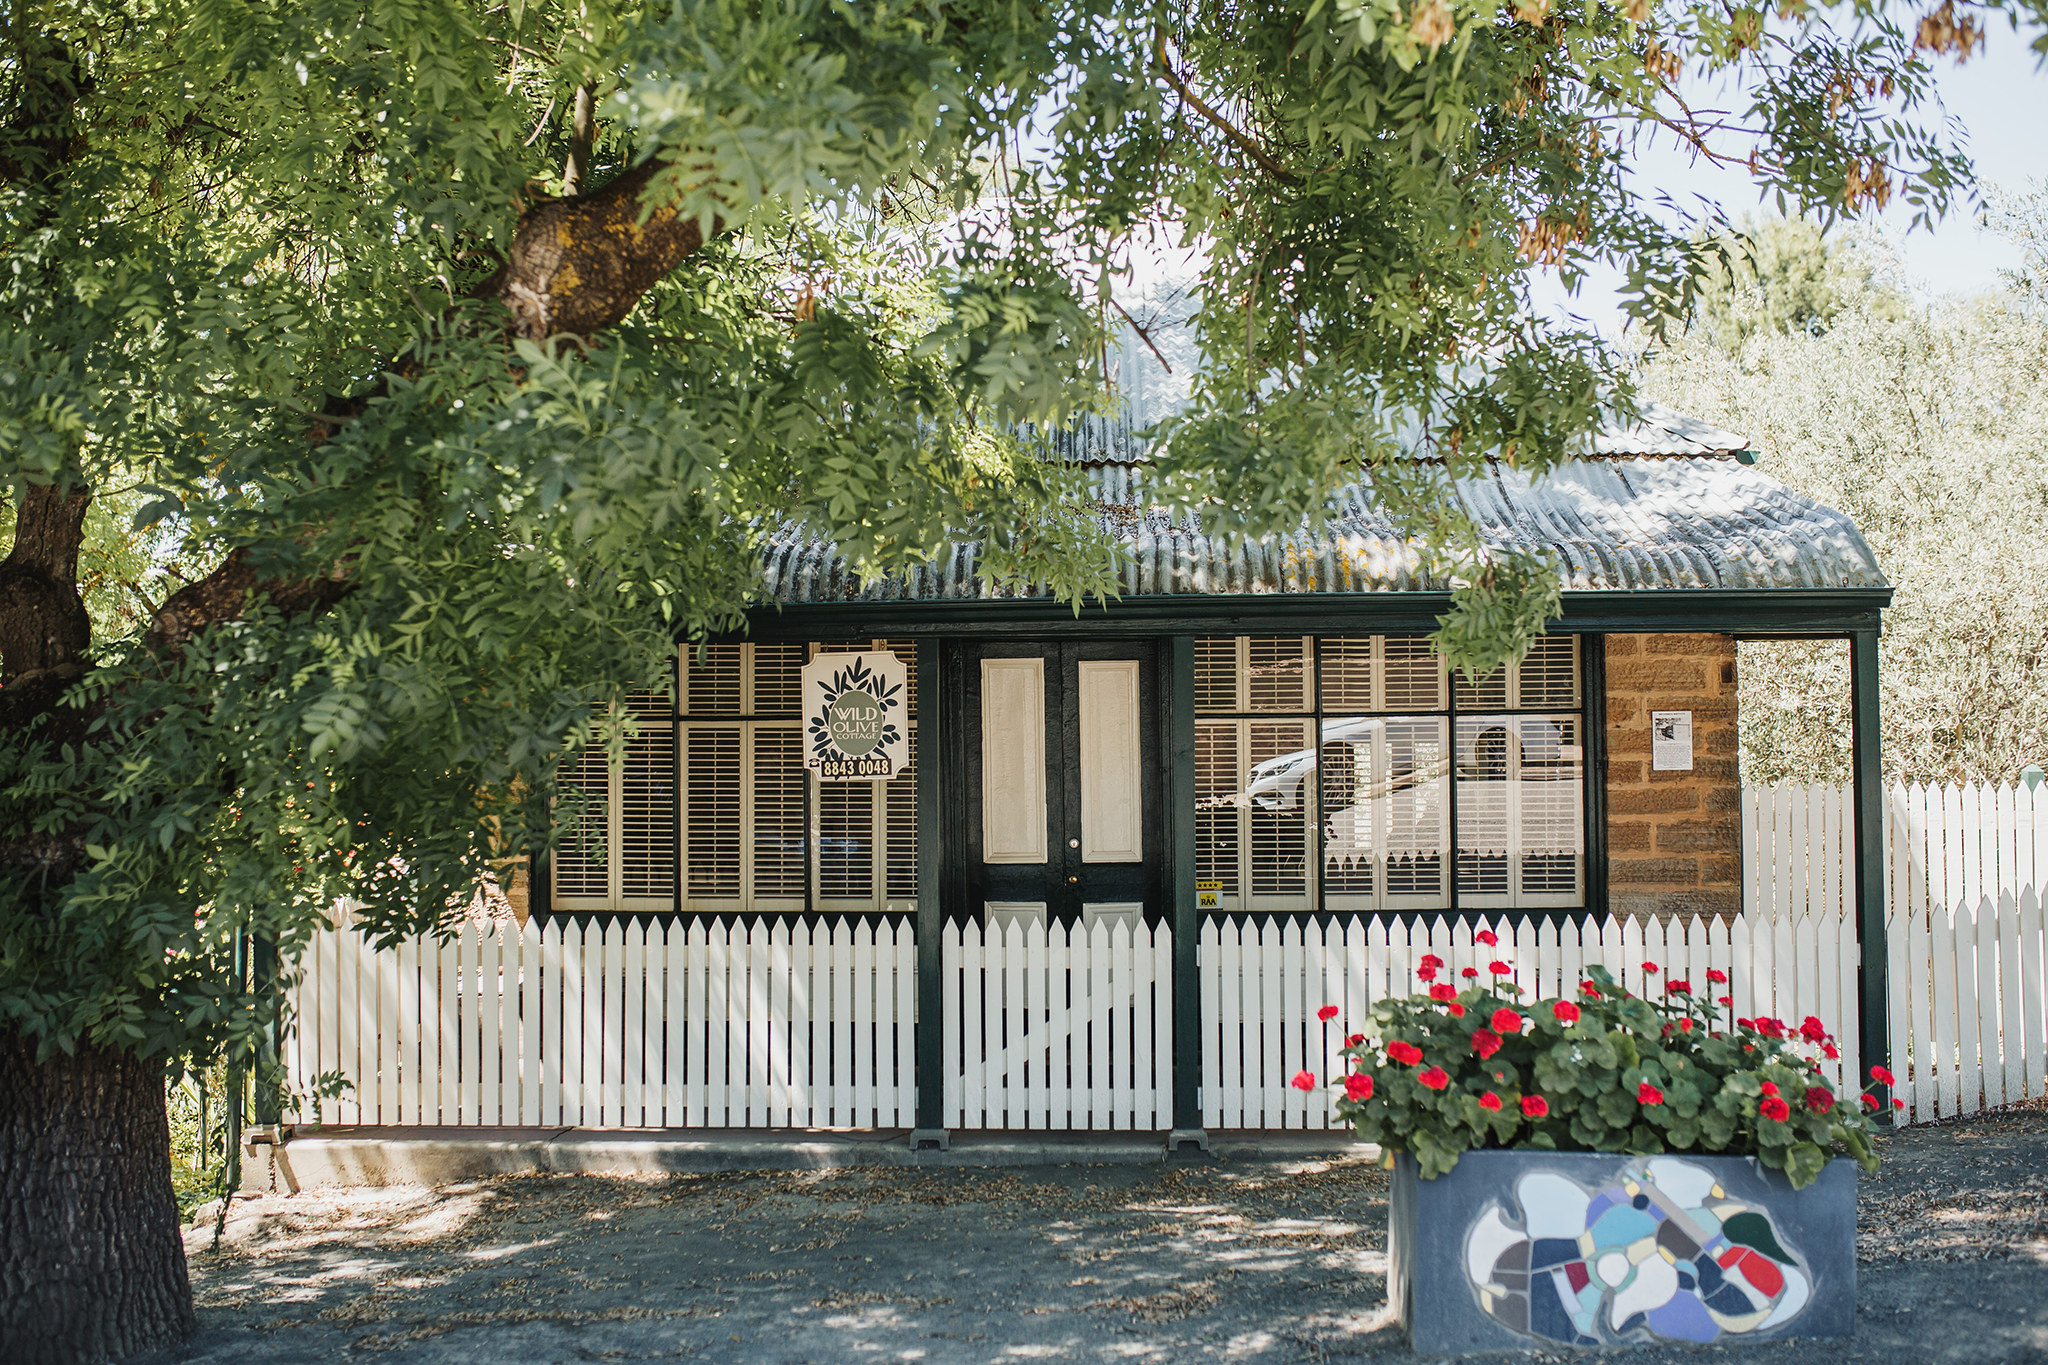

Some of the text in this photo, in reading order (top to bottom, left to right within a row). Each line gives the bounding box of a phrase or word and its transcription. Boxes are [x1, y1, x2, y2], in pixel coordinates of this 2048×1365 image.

[833, 707, 878, 721] WILD
[833, 721, 879, 733] OLIVE
[824, 760, 889, 776] 8843 0048
[1201, 898, 1217, 906] RAA
